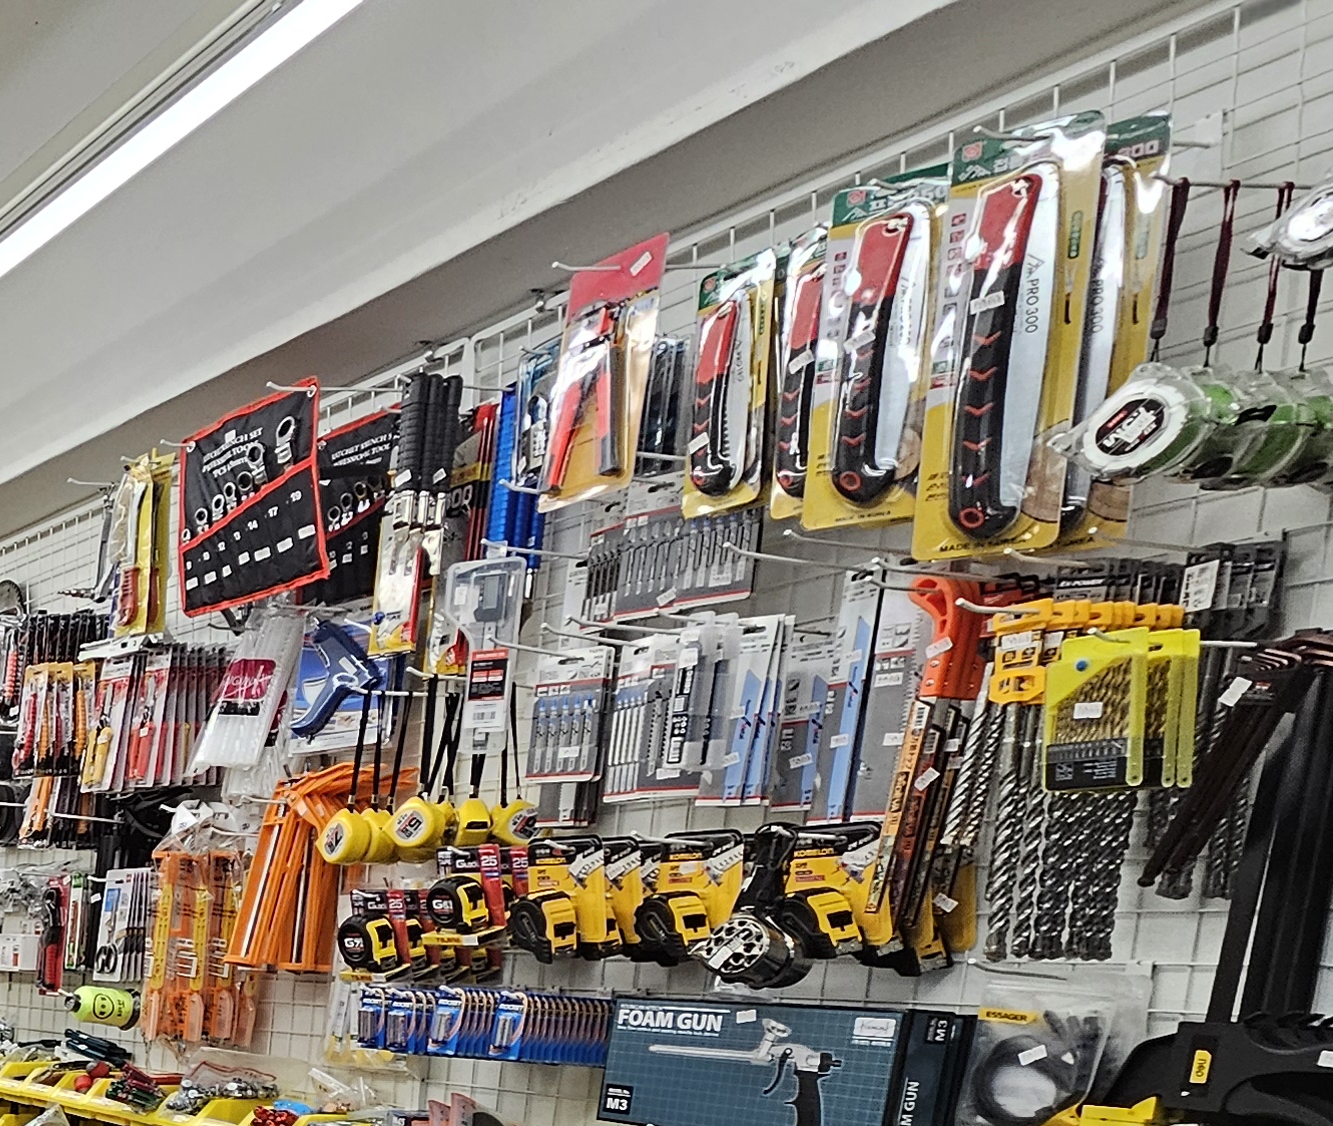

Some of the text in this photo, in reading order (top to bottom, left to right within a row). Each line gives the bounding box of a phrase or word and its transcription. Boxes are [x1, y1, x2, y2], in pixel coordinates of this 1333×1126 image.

[1024, 278, 1041, 335] PRO 300
[481, 856, 499, 867] 25
[388, 898, 404, 910] 25
[617, 1009, 674, 1029] FOAM
[677, 1012, 723, 1032] GUN
[984, 1011, 1028, 1024] ESSAGER
[935, 1019, 948, 1043] M3
[607, 1095, 630, 1112] M3
[903, 1081, 919, 1113] GUN
